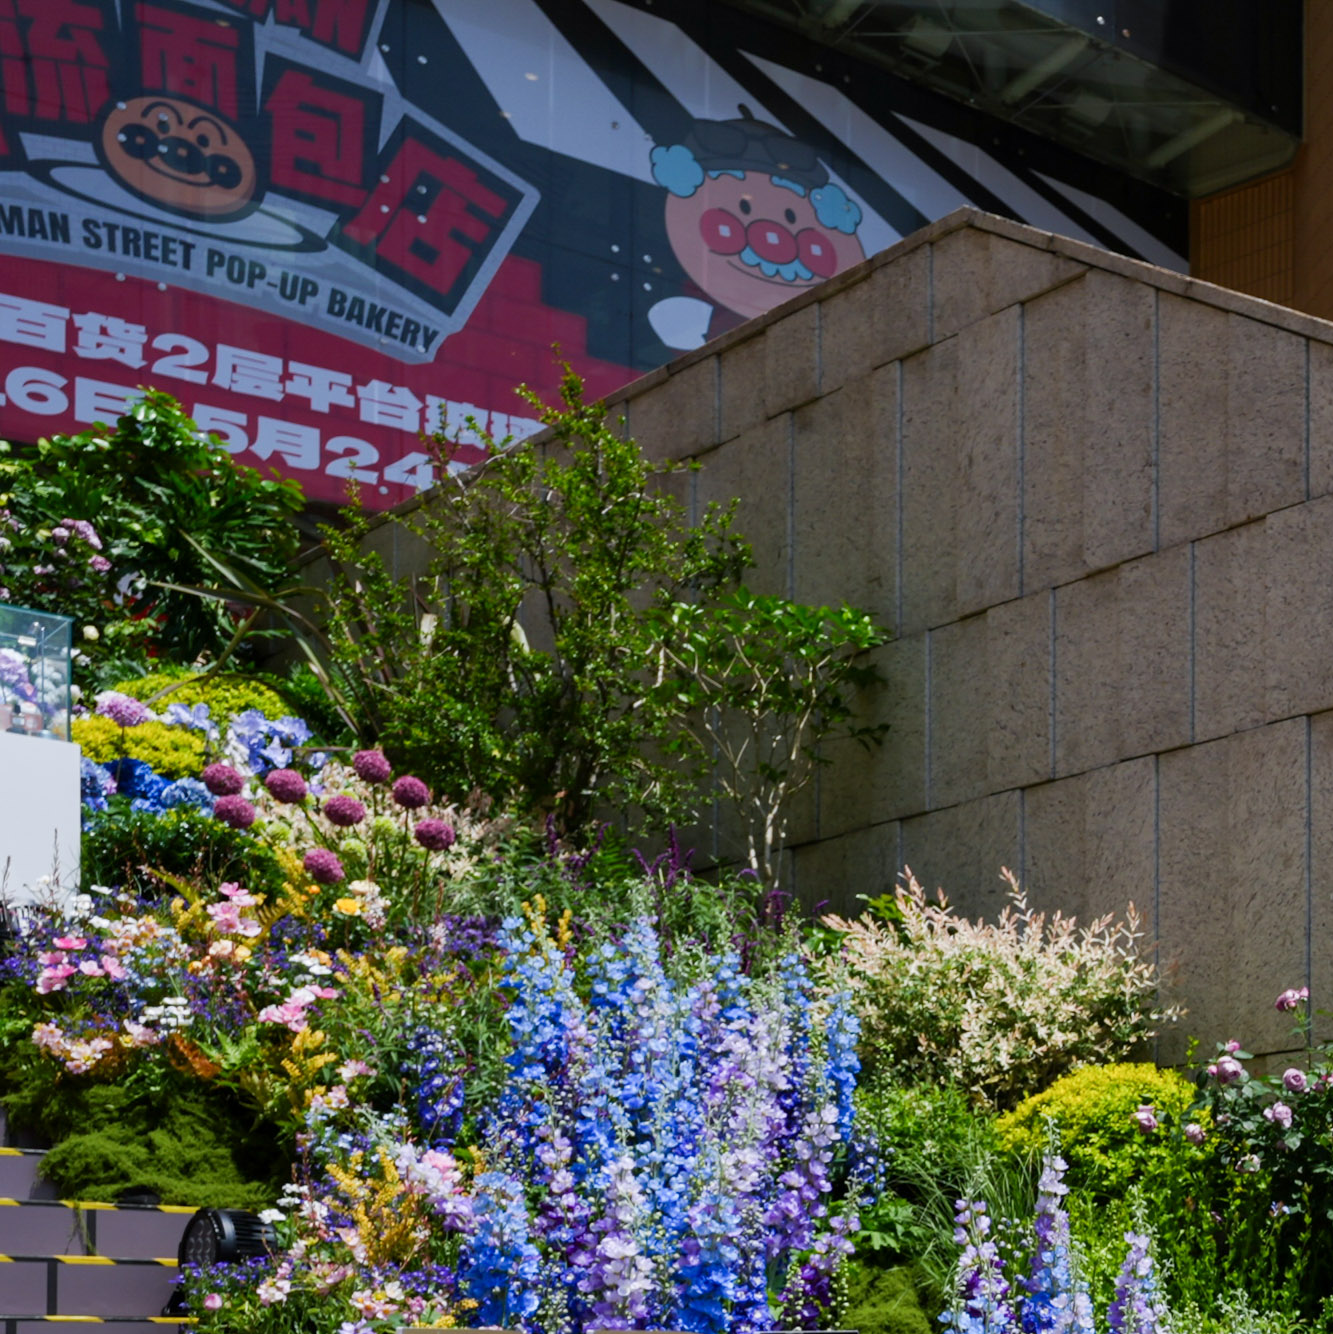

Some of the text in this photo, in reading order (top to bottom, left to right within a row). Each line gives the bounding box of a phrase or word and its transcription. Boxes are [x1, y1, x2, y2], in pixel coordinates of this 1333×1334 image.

[82, 217, 196, 271] STREET
[206, 248, 319, 306] POP-UP
[326, 287, 440, 354] BAKERY
